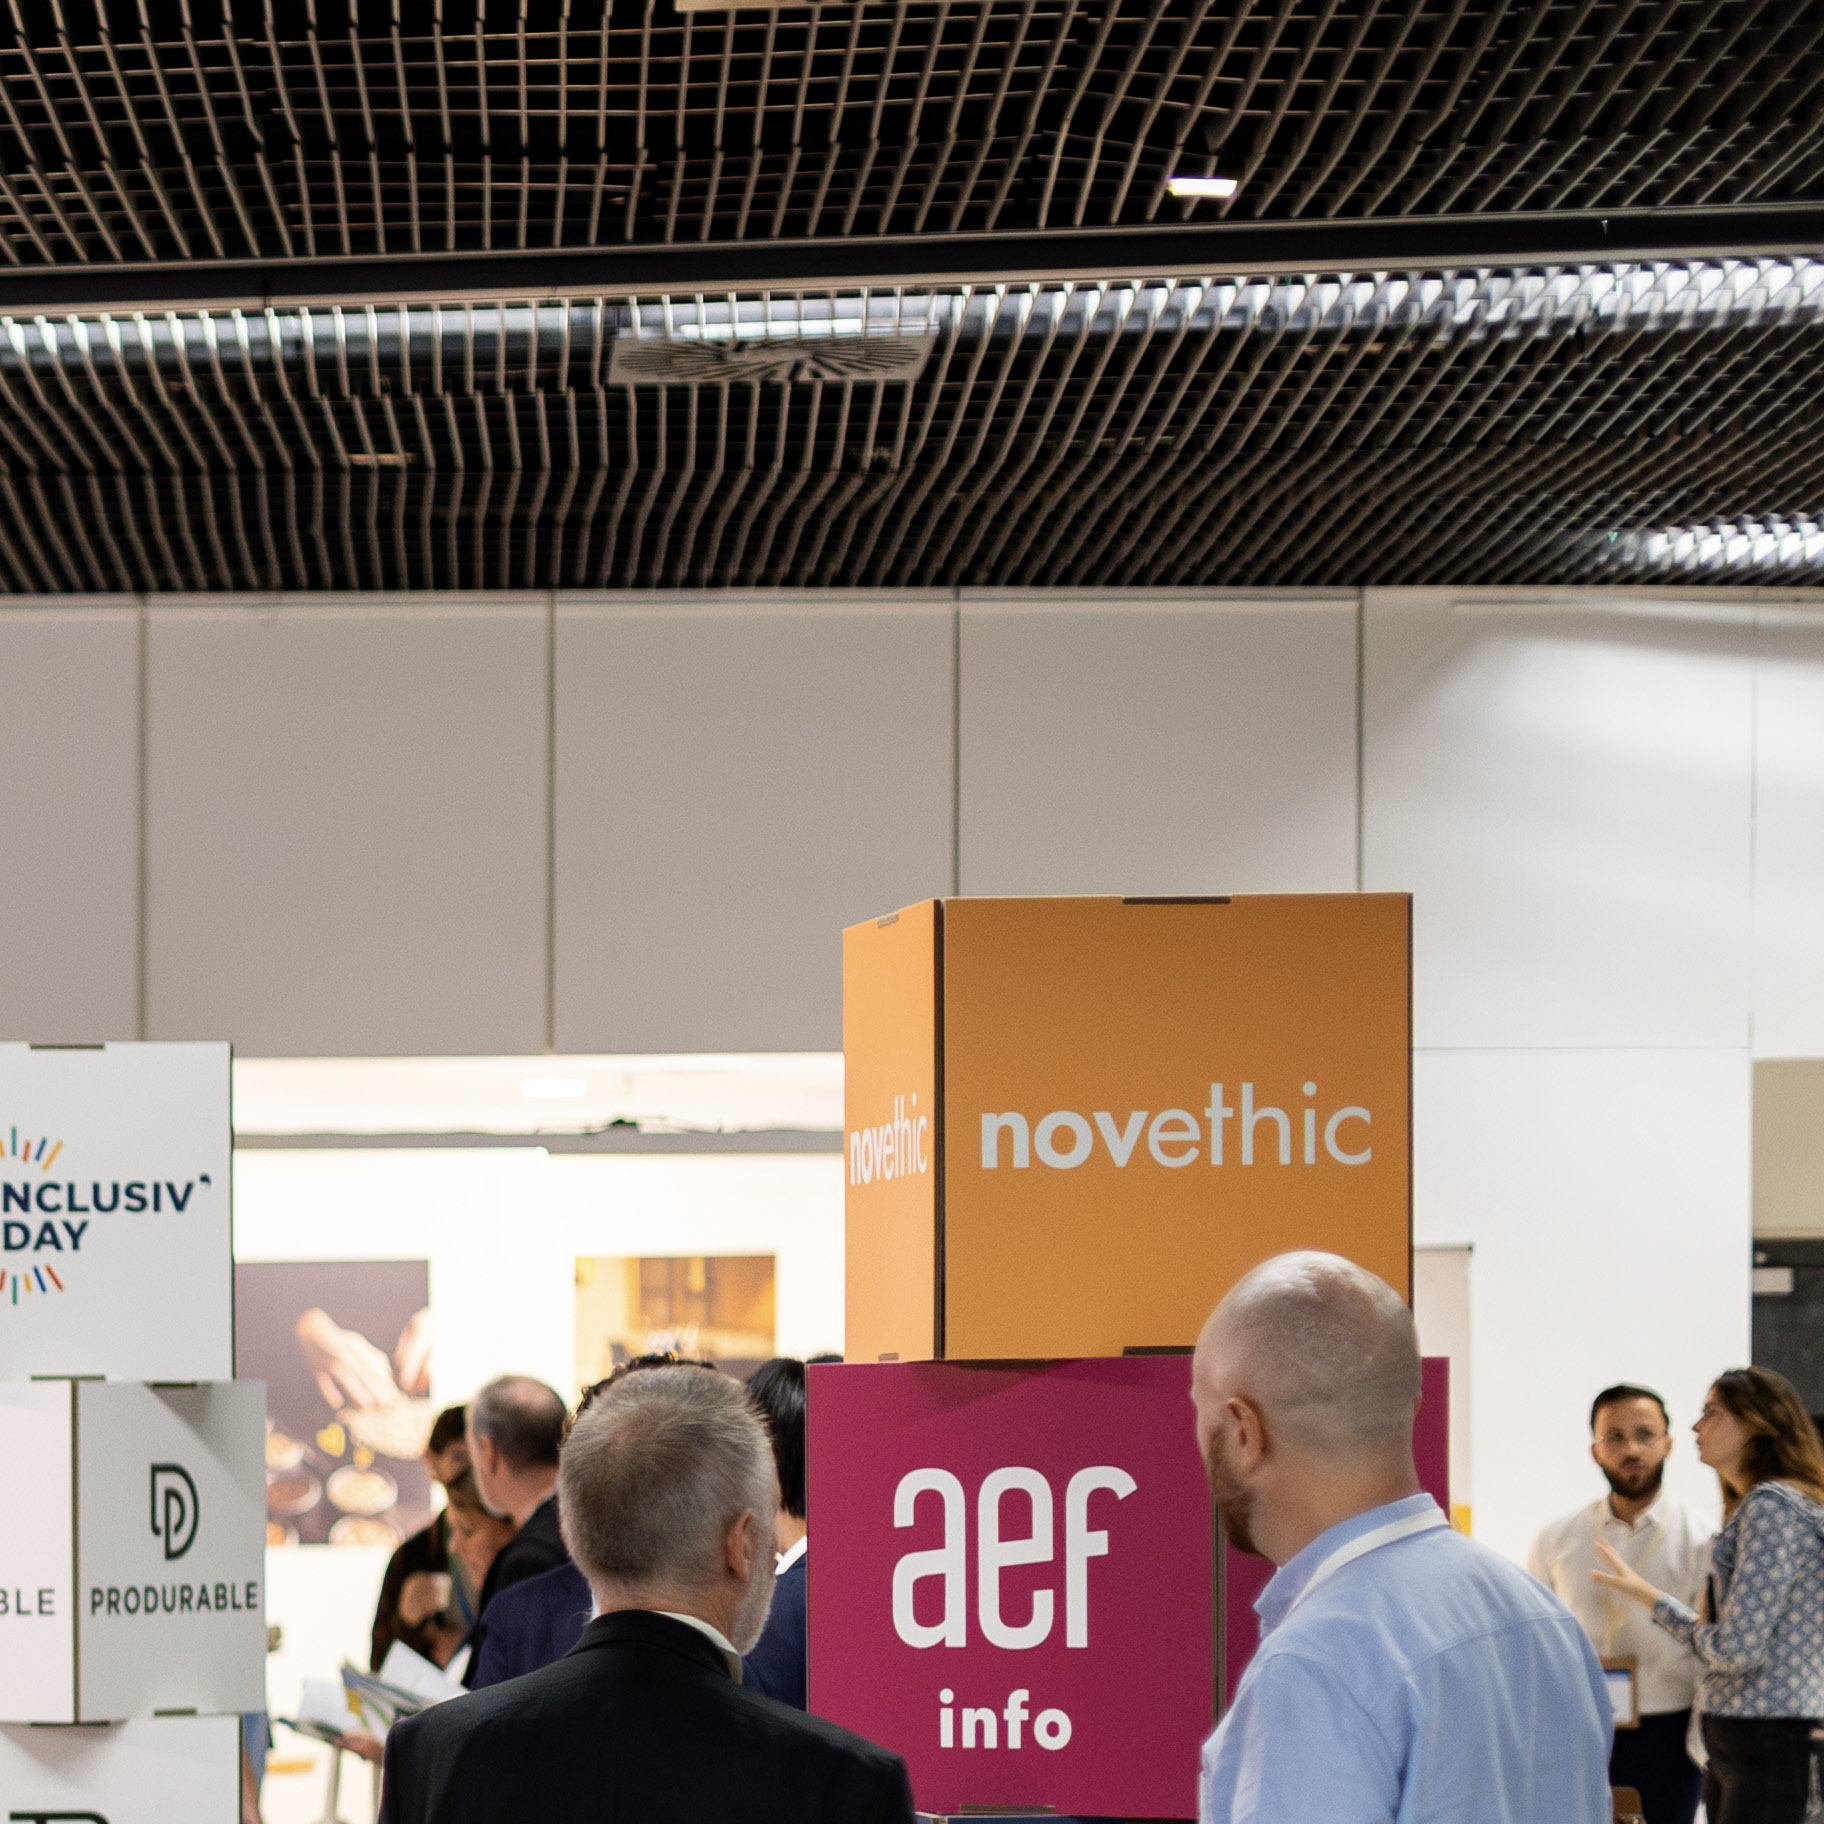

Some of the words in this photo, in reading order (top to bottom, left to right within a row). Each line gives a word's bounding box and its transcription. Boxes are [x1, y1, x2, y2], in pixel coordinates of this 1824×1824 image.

[849, 1092, 928, 1186] novethic
[981, 1081, 1372, 1169] novethic
[2, 1220, 89, 1252] DAY
[891, 1465, 1138, 1650] aef
[90, 1580, 259, 1617] PRODURABLE
[939, 1688, 1072, 1751] info
